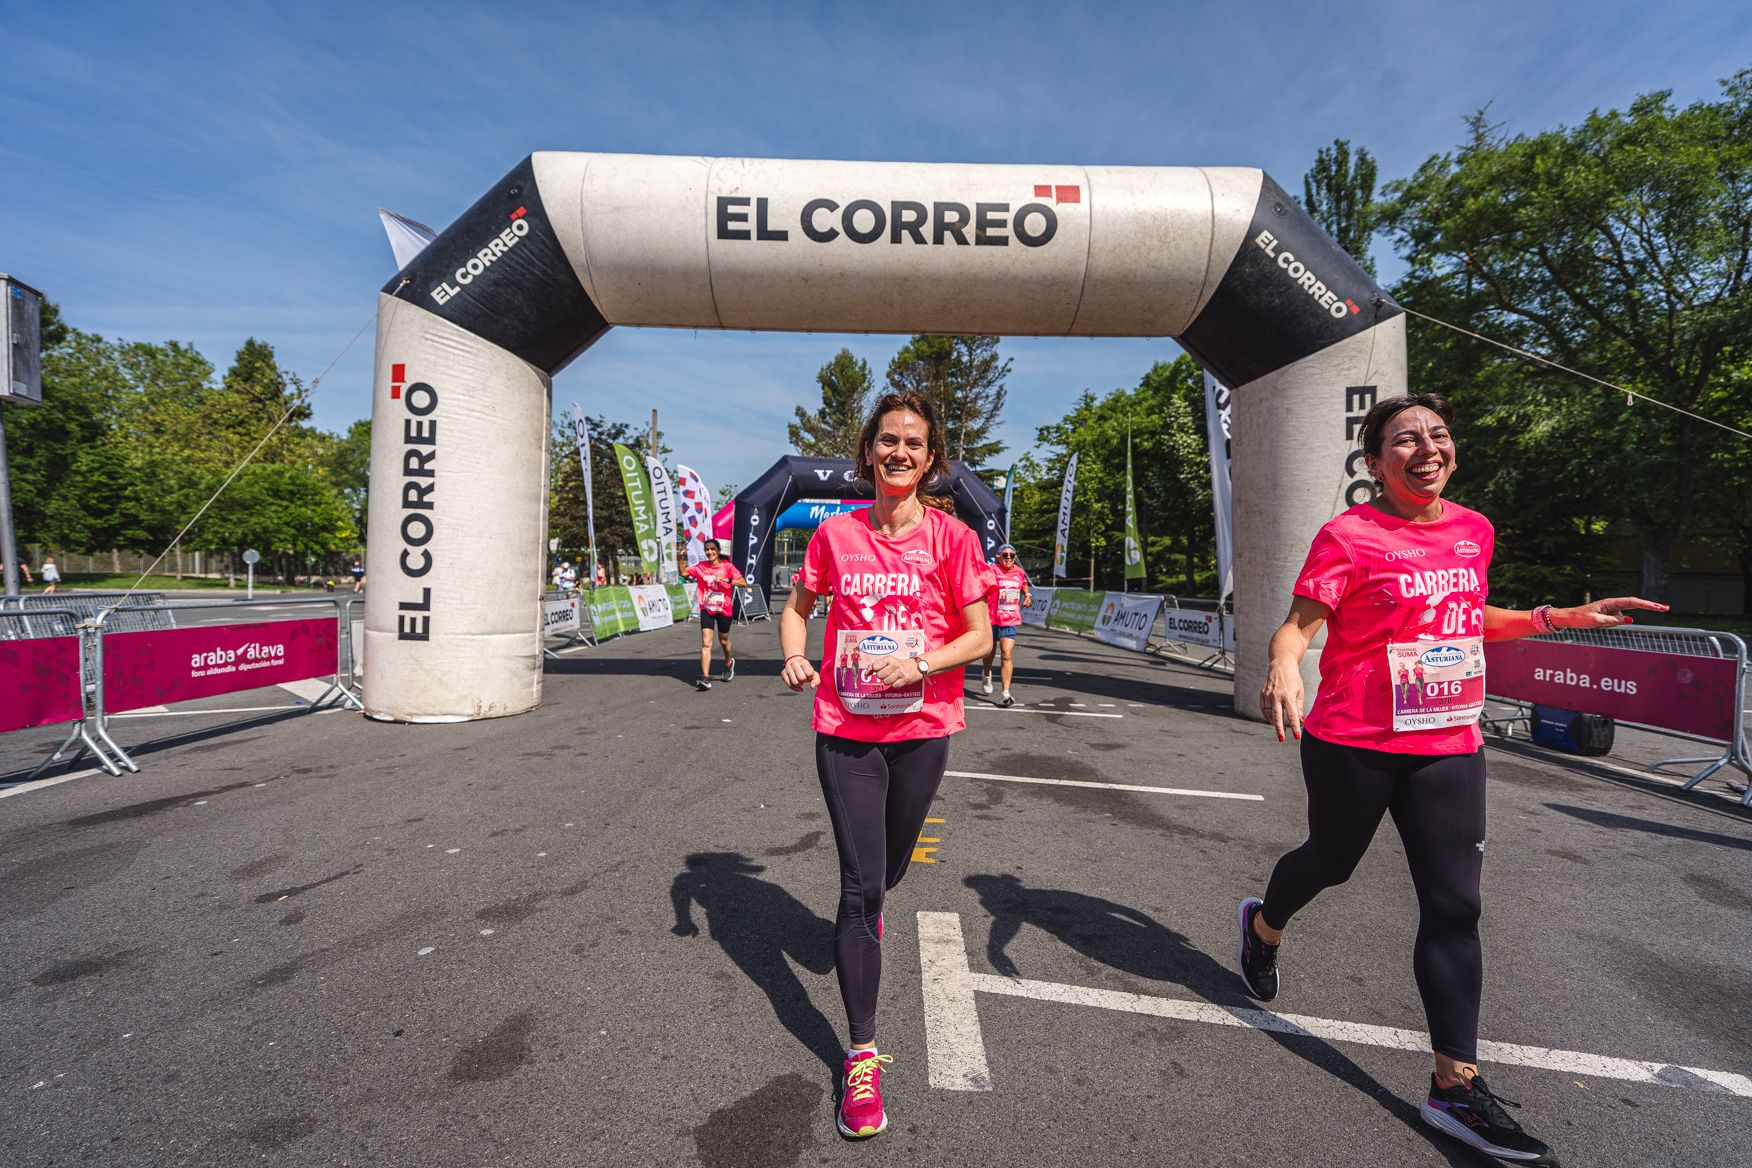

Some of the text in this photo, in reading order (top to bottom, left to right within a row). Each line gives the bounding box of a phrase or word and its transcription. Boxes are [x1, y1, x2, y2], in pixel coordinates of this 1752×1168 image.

[716, 195, 1058, 247] EL CORREO
[430, 218, 529, 306] EL CORREO
[1255, 229, 1348, 318] EL CORREO
[397, 382, 438, 641] EL CORREO
[841, 553, 876, 562] OYSHO
[1385, 548, 1426, 562] OYSHO
[841, 573, 921, 596] CARRERA
[1399, 567, 1481, 598] CARRERA
[1113, 609, 1148, 631] AMUTIO
[1169, 617, 1209, 635] EL CORREO
[191, 643, 284, 668] araba álava
[862, 642, 896, 651] ASTURIANA
[206, 665, 236, 676] aldundia
[238, 660, 270, 672] diputación
[270, 658, 284, 666] foral
[1424, 654, 1463, 663] ASTURIANA
[1426, 681, 1463, 697] 016
[1534, 667, 1638, 695] araba.eus
[1404, 716, 1436, 726] OYSHO
[1453, 713, 1477, 721] Santander
